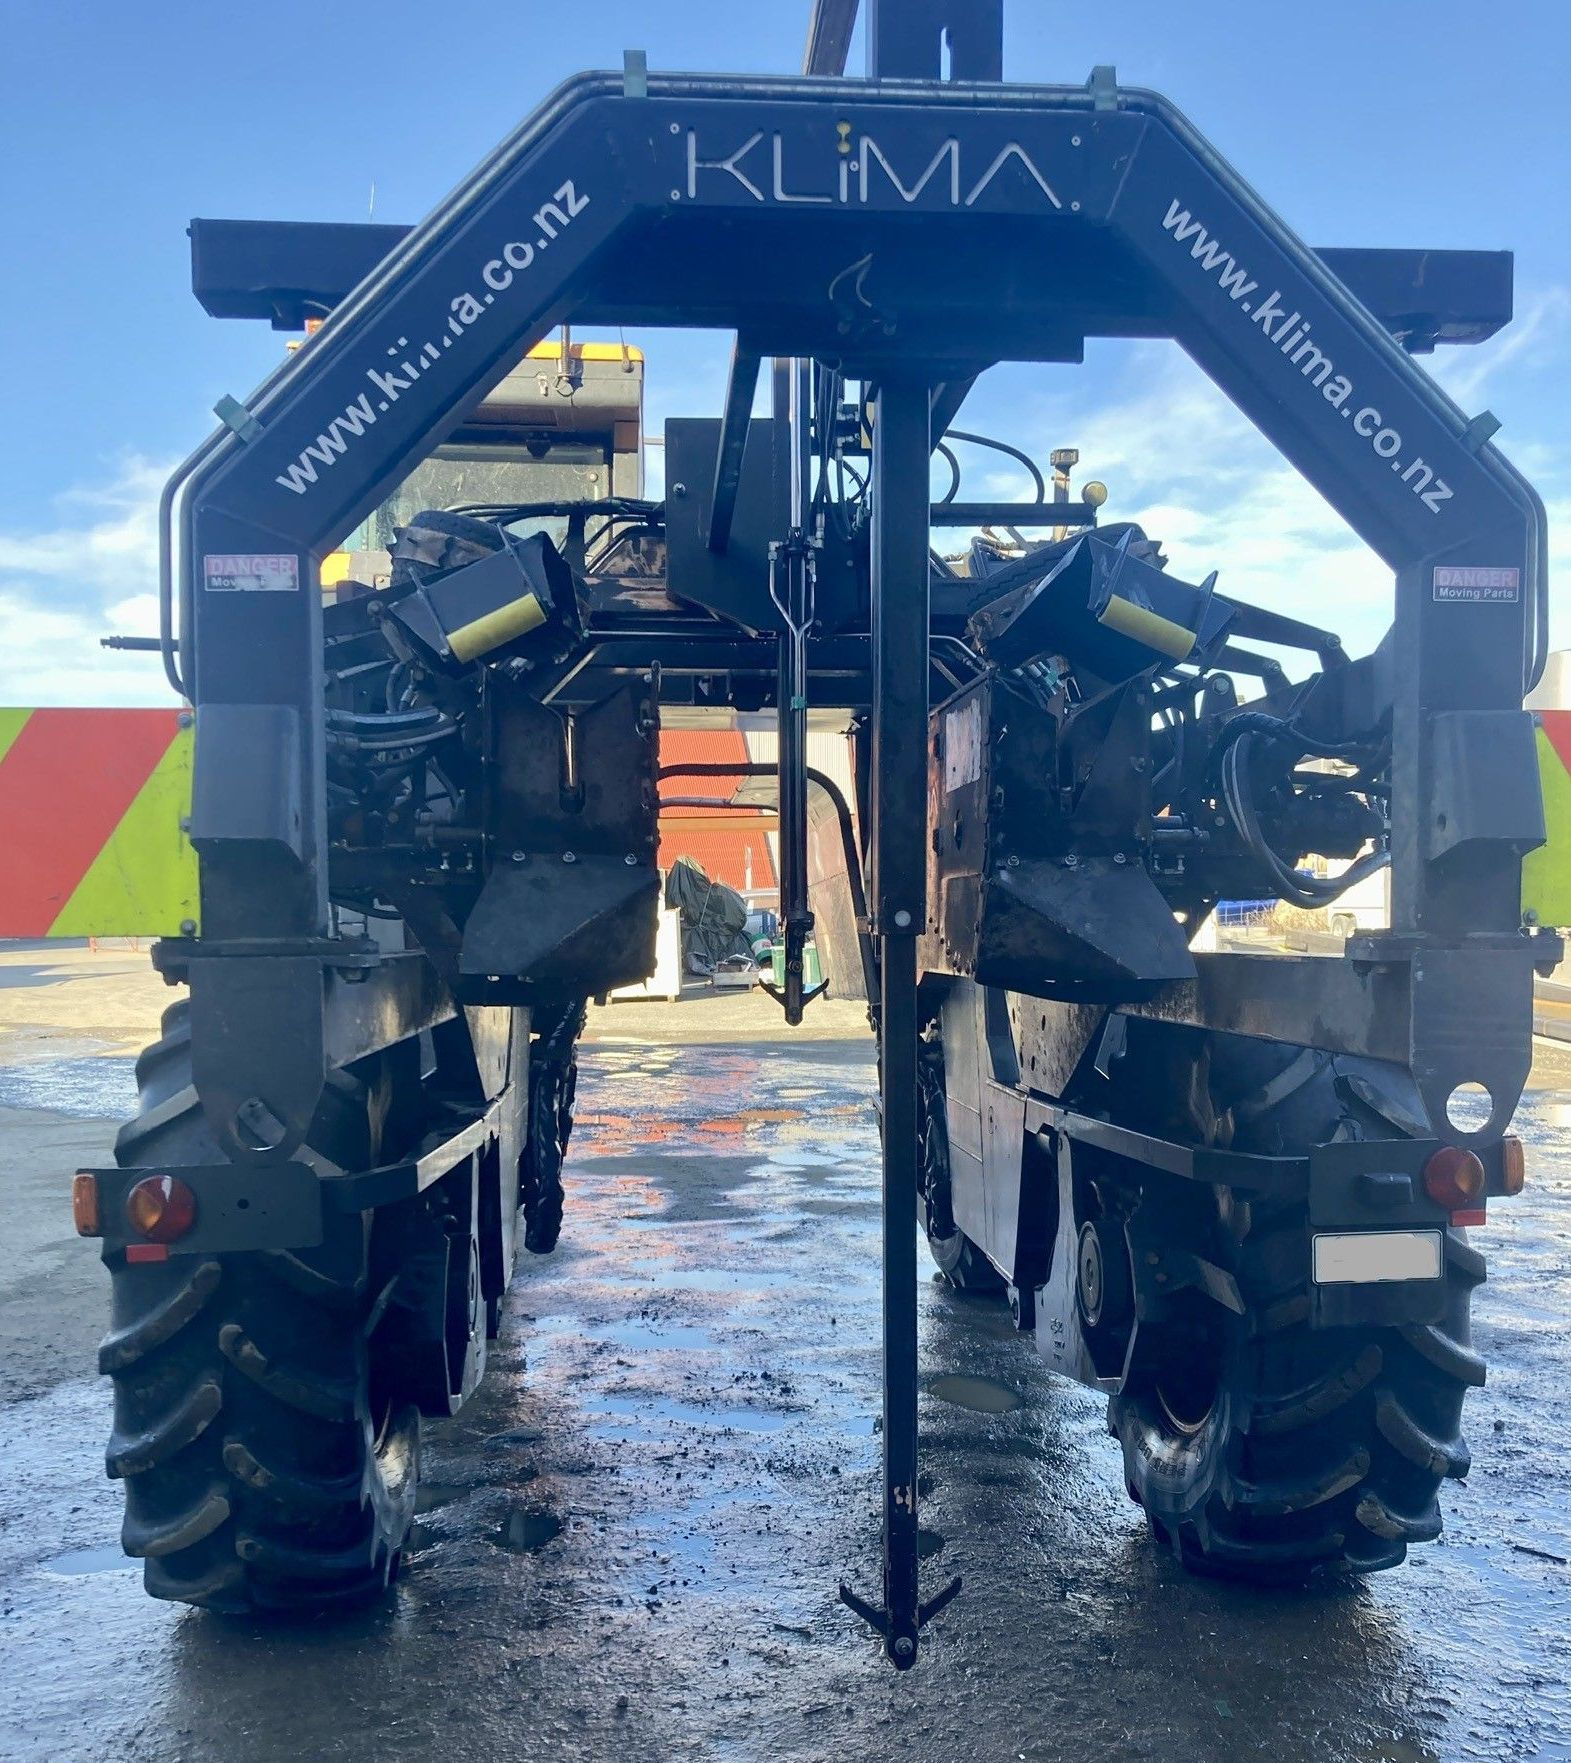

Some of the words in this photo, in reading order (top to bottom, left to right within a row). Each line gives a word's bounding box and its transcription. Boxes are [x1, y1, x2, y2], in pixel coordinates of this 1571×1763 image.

[1161, 198, 1454, 514] www.klima.co.nz
[211, 558, 292, 576] DANGER
[211, 577, 253, 588] Mov
[1439, 570, 1513, 587] DANGER
[1439, 588, 1480, 599] Moving
[1484, 588, 1514, 599] Parts
